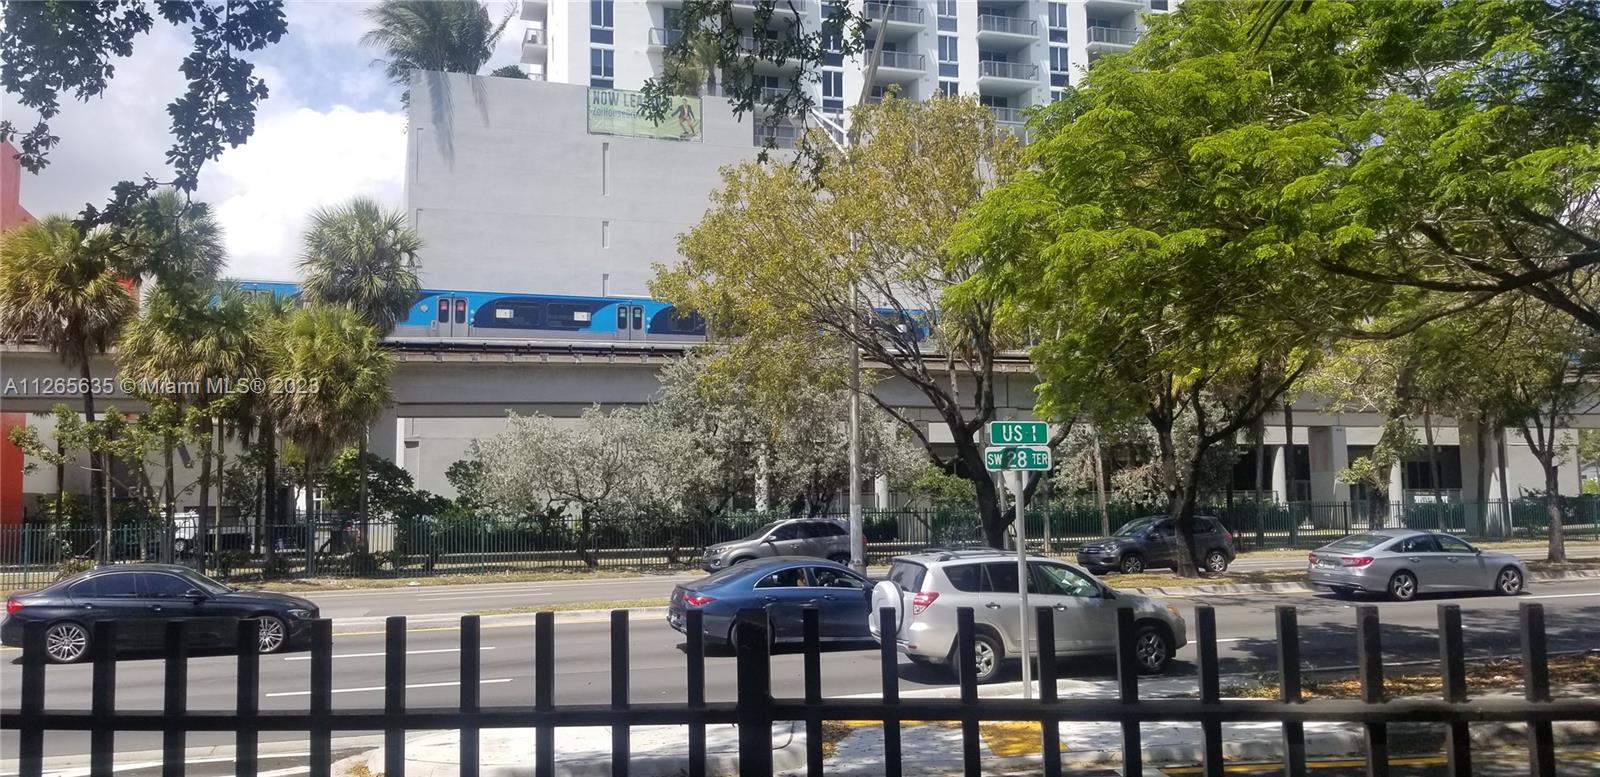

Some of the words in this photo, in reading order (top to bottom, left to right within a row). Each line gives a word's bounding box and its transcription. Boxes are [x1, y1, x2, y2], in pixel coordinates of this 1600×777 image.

[593, 91, 620, 106] NOW
[1002, 424, 1023, 442] US
[1031, 424, 1037, 442] 1
[987, 453, 1003, 465] SW
[1006, 450, 1028, 468] 28
[1031, 453, 1048, 465] TER
